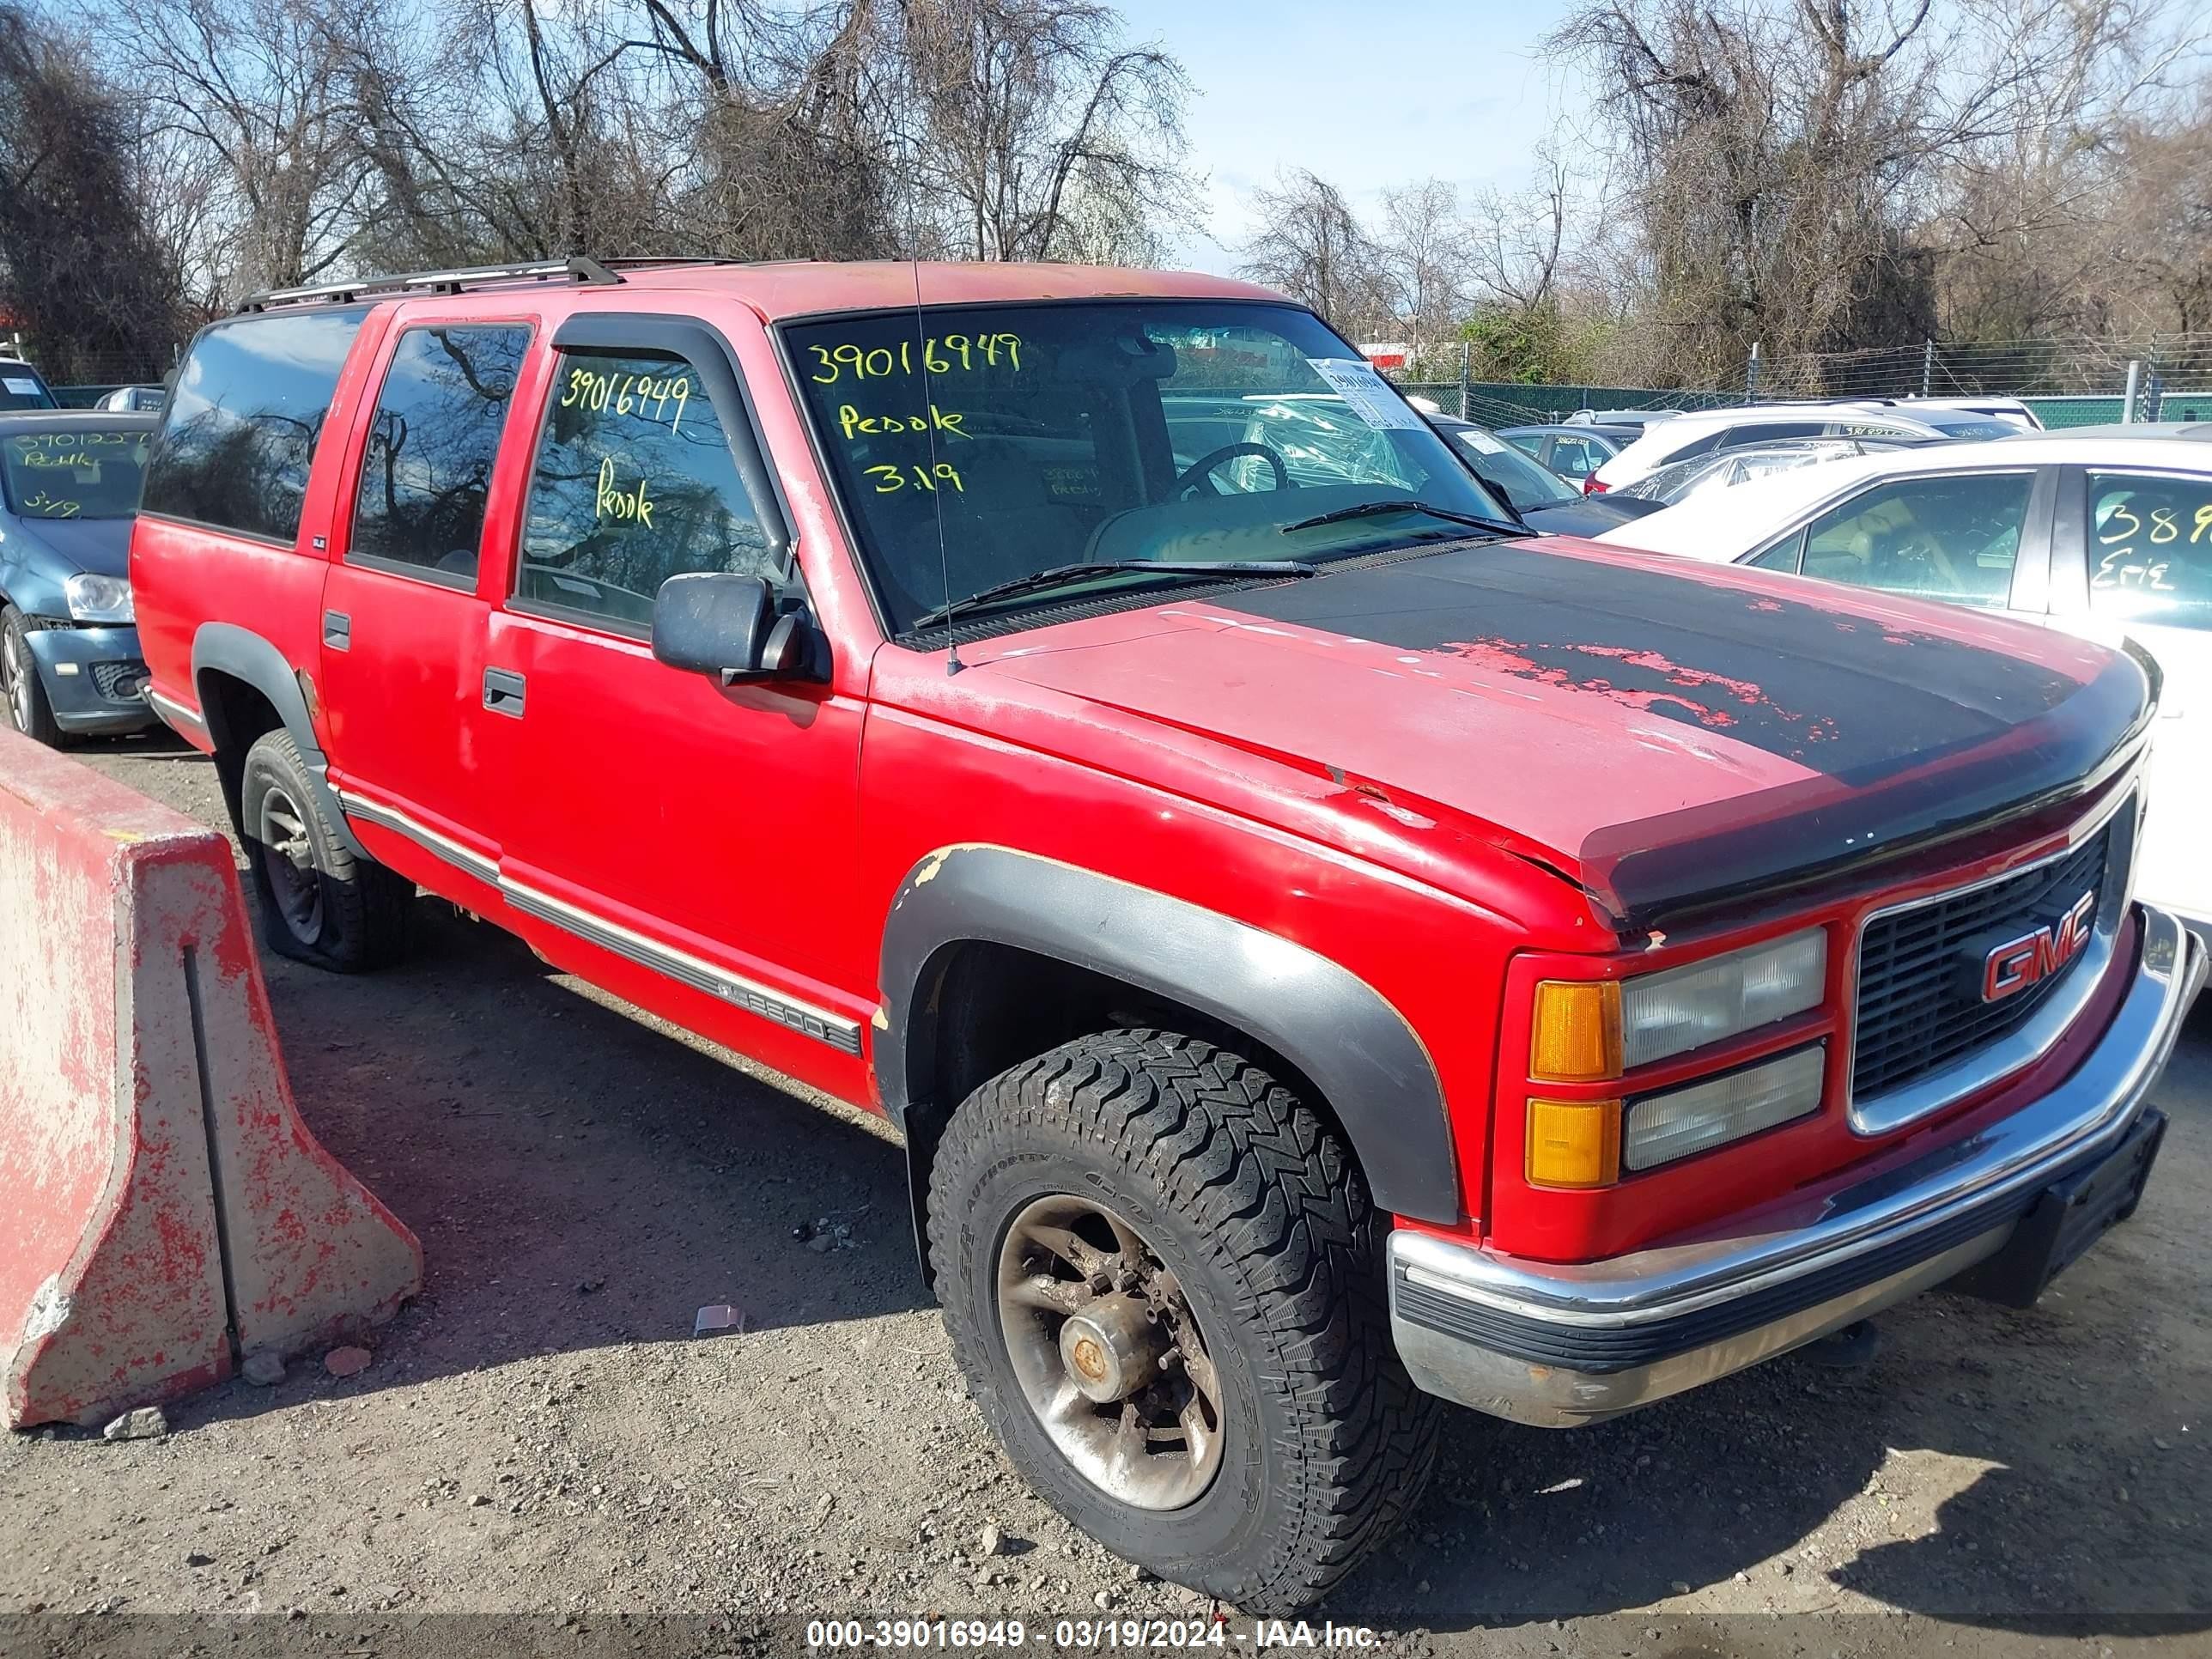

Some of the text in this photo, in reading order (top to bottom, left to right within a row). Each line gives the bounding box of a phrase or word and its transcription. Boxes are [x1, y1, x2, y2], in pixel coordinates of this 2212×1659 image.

[809, 333, 1022, 384] 39016949
[561, 368, 689, 436] 39016949
[15, 432, 154, 450] 3901227
[2095, 504, 2212, 545] 389
[1981, 889, 2094, 1004] GMC
[747, 993, 828, 1039] 2500
[966, 1152, 1049, 1213] AUTHORITY
[1085, 1170, 1266, 1514] GOODYEAR
